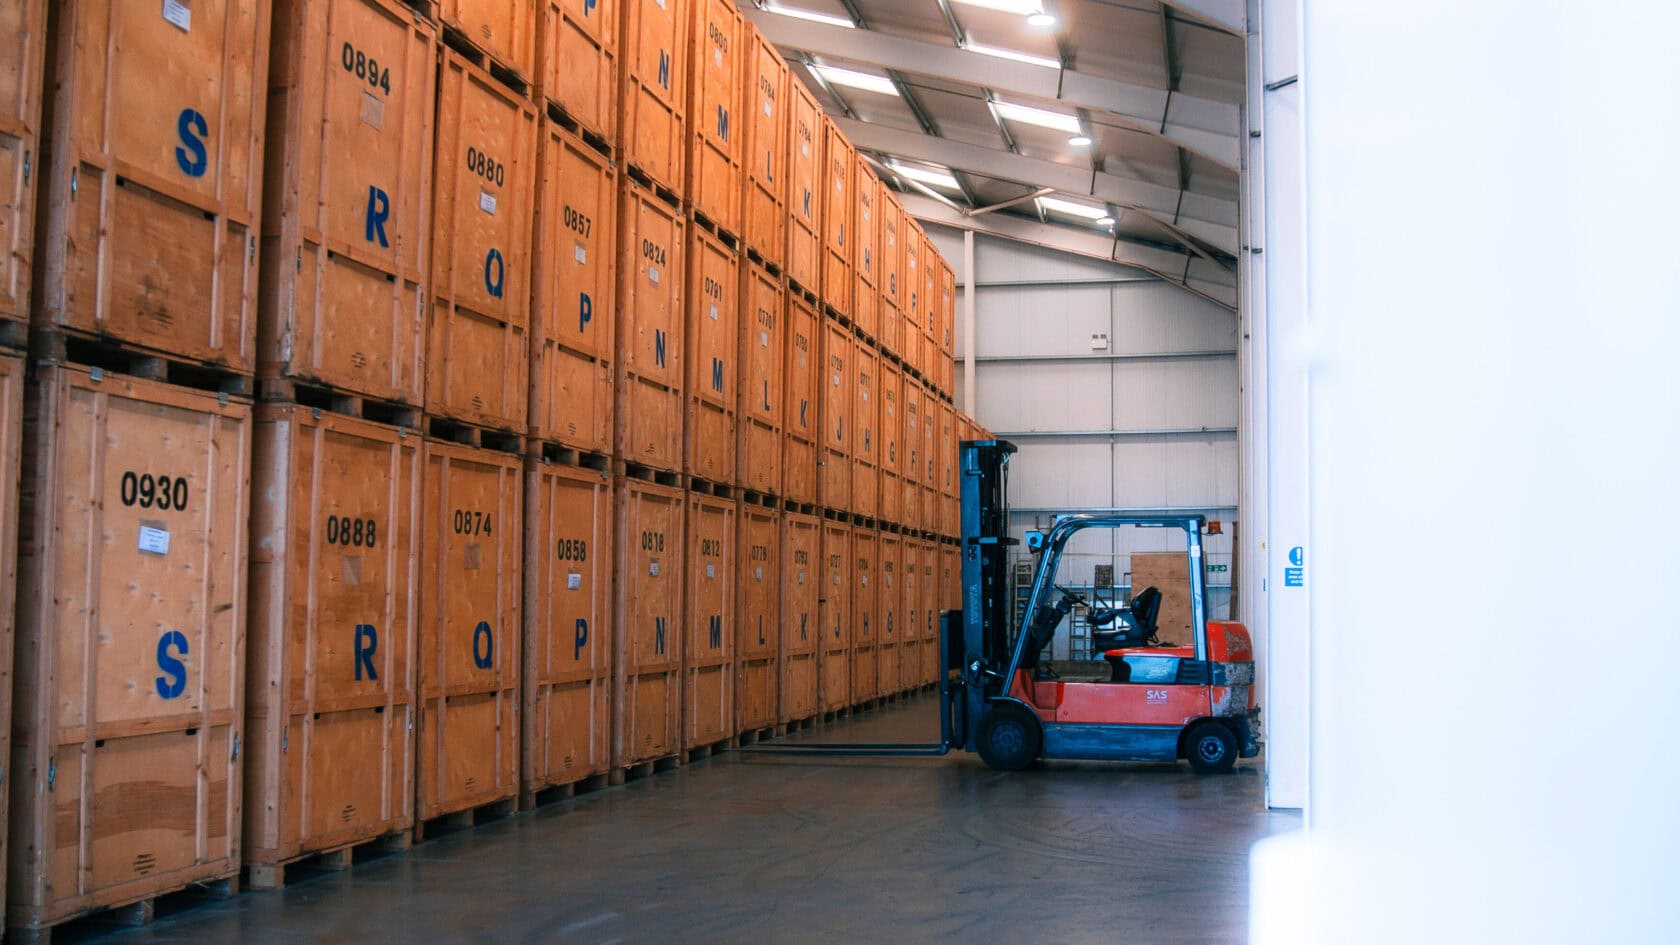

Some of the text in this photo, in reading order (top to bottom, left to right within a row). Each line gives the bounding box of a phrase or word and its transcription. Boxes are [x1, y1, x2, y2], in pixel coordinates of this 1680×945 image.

[709, 22, 729, 54] 0800
[342, 42, 391, 96] 0894
[658, 48, 669, 90] N
[717, 104, 728, 142] M
[176, 108, 208, 178] S
[467, 146, 504, 188] 0880
[767, 151, 773, 182] L
[365, 185, 390, 248] R
[803, 188, 810, 219] K
[564, 204, 592, 239] 0857
[838, 223, 843, 247] J
[643, 238, 666, 268] 0824
[865, 247, 870, 273] H
[485, 248, 504, 299] Q
[890, 272, 896, 295] G
[706, 276, 722, 303] 0791
[580, 292, 592, 333] P
[655, 328, 666, 369] N
[712, 357, 723, 393] M
[764, 380, 770, 411] L
[801, 399, 807, 428] K
[837, 416, 842, 441] J
[865, 428, 870, 453] H
[890, 441, 895, 463] G
[121, 471, 188, 512] 0930
[327, 515, 377, 548] 0888
[454, 509, 492, 536] 0874
[558, 538, 586, 562] 0858
[642, 531, 664, 552] 0818
[703, 539, 720, 557] 0812
[709, 615, 721, 649] M
[759, 614, 766, 645] L
[801, 612, 807, 640] K
[834, 611, 840, 639] J
[863, 611, 868, 635] H
[887, 611, 893, 633] G
[910, 609, 914, 630] F
[928, 609, 932, 630] E
[473, 620, 493, 670] Q
[574, 618, 588, 660] P
[655, 616, 665, 656] N
[155, 631, 189, 700] S
[354, 624, 378, 681] R
[1146, 690, 1168, 699] SAS
